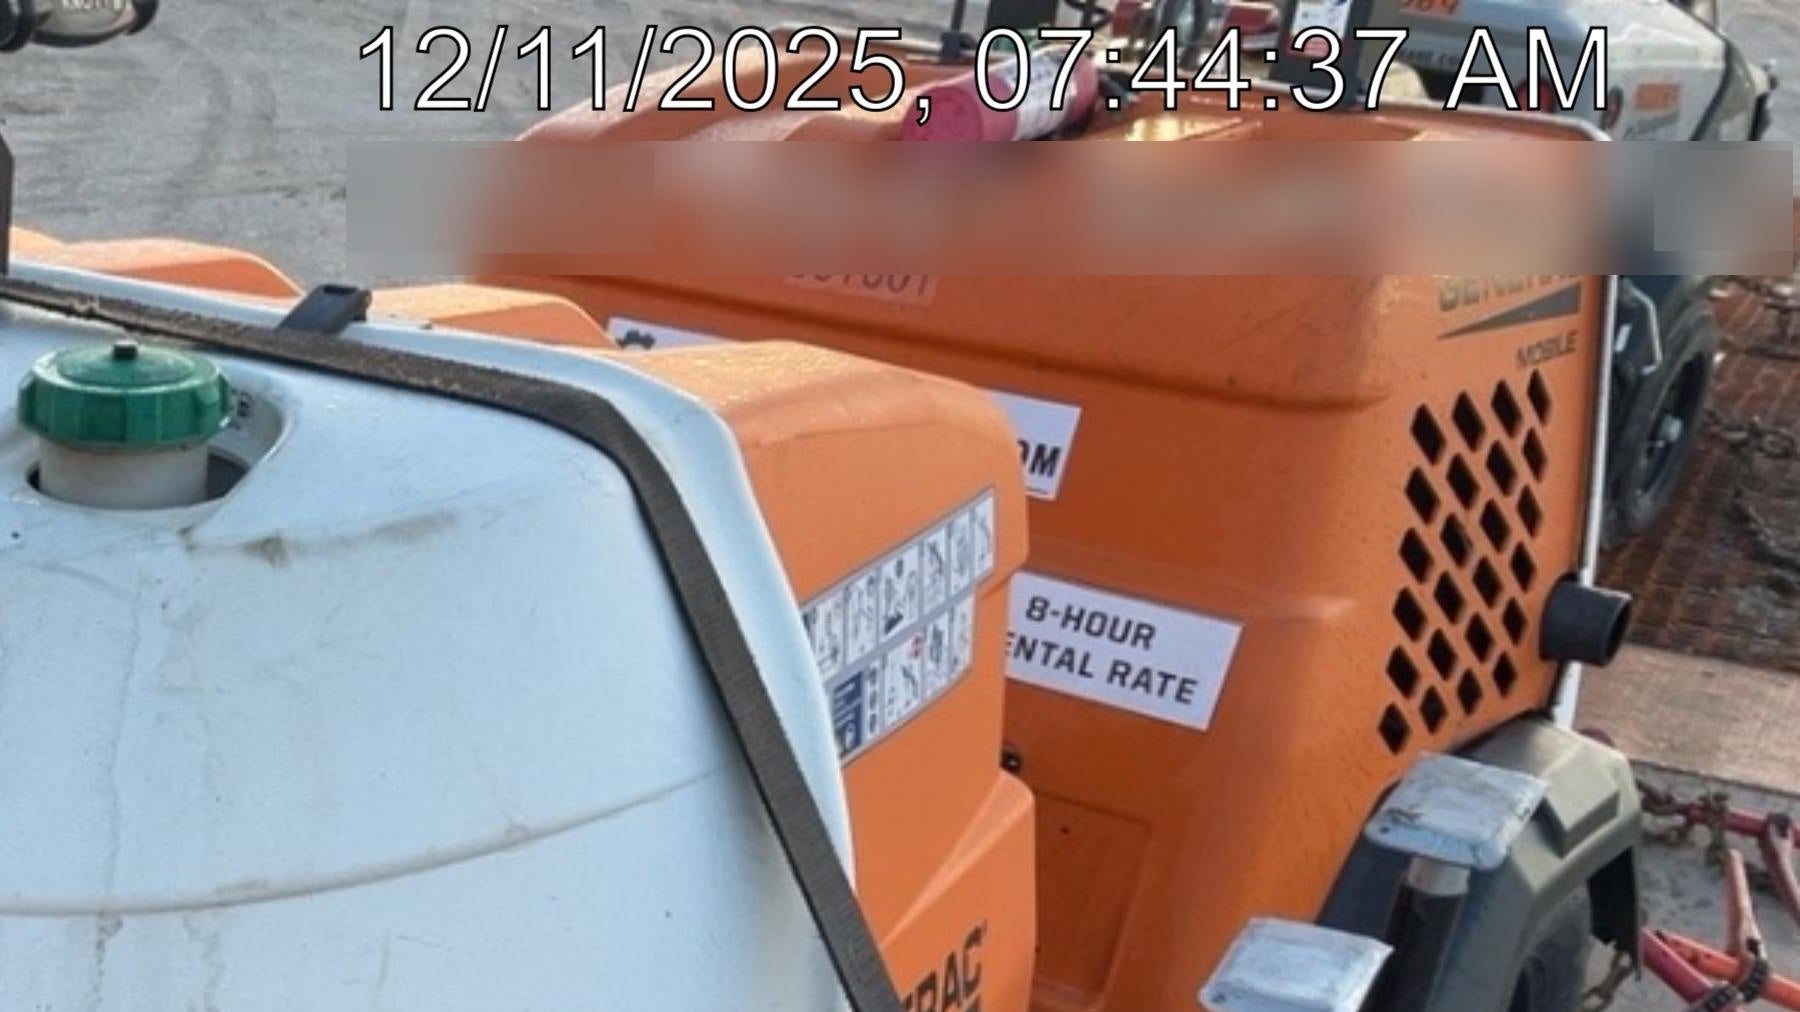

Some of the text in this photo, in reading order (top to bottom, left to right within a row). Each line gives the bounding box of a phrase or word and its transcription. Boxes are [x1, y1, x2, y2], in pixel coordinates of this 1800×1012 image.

[1516, 329, 1579, 366] MOBILE
[1025, 595, 1157, 652] 8-HOUR
[1006, 631, 1199, 706] ENTAL RATE
